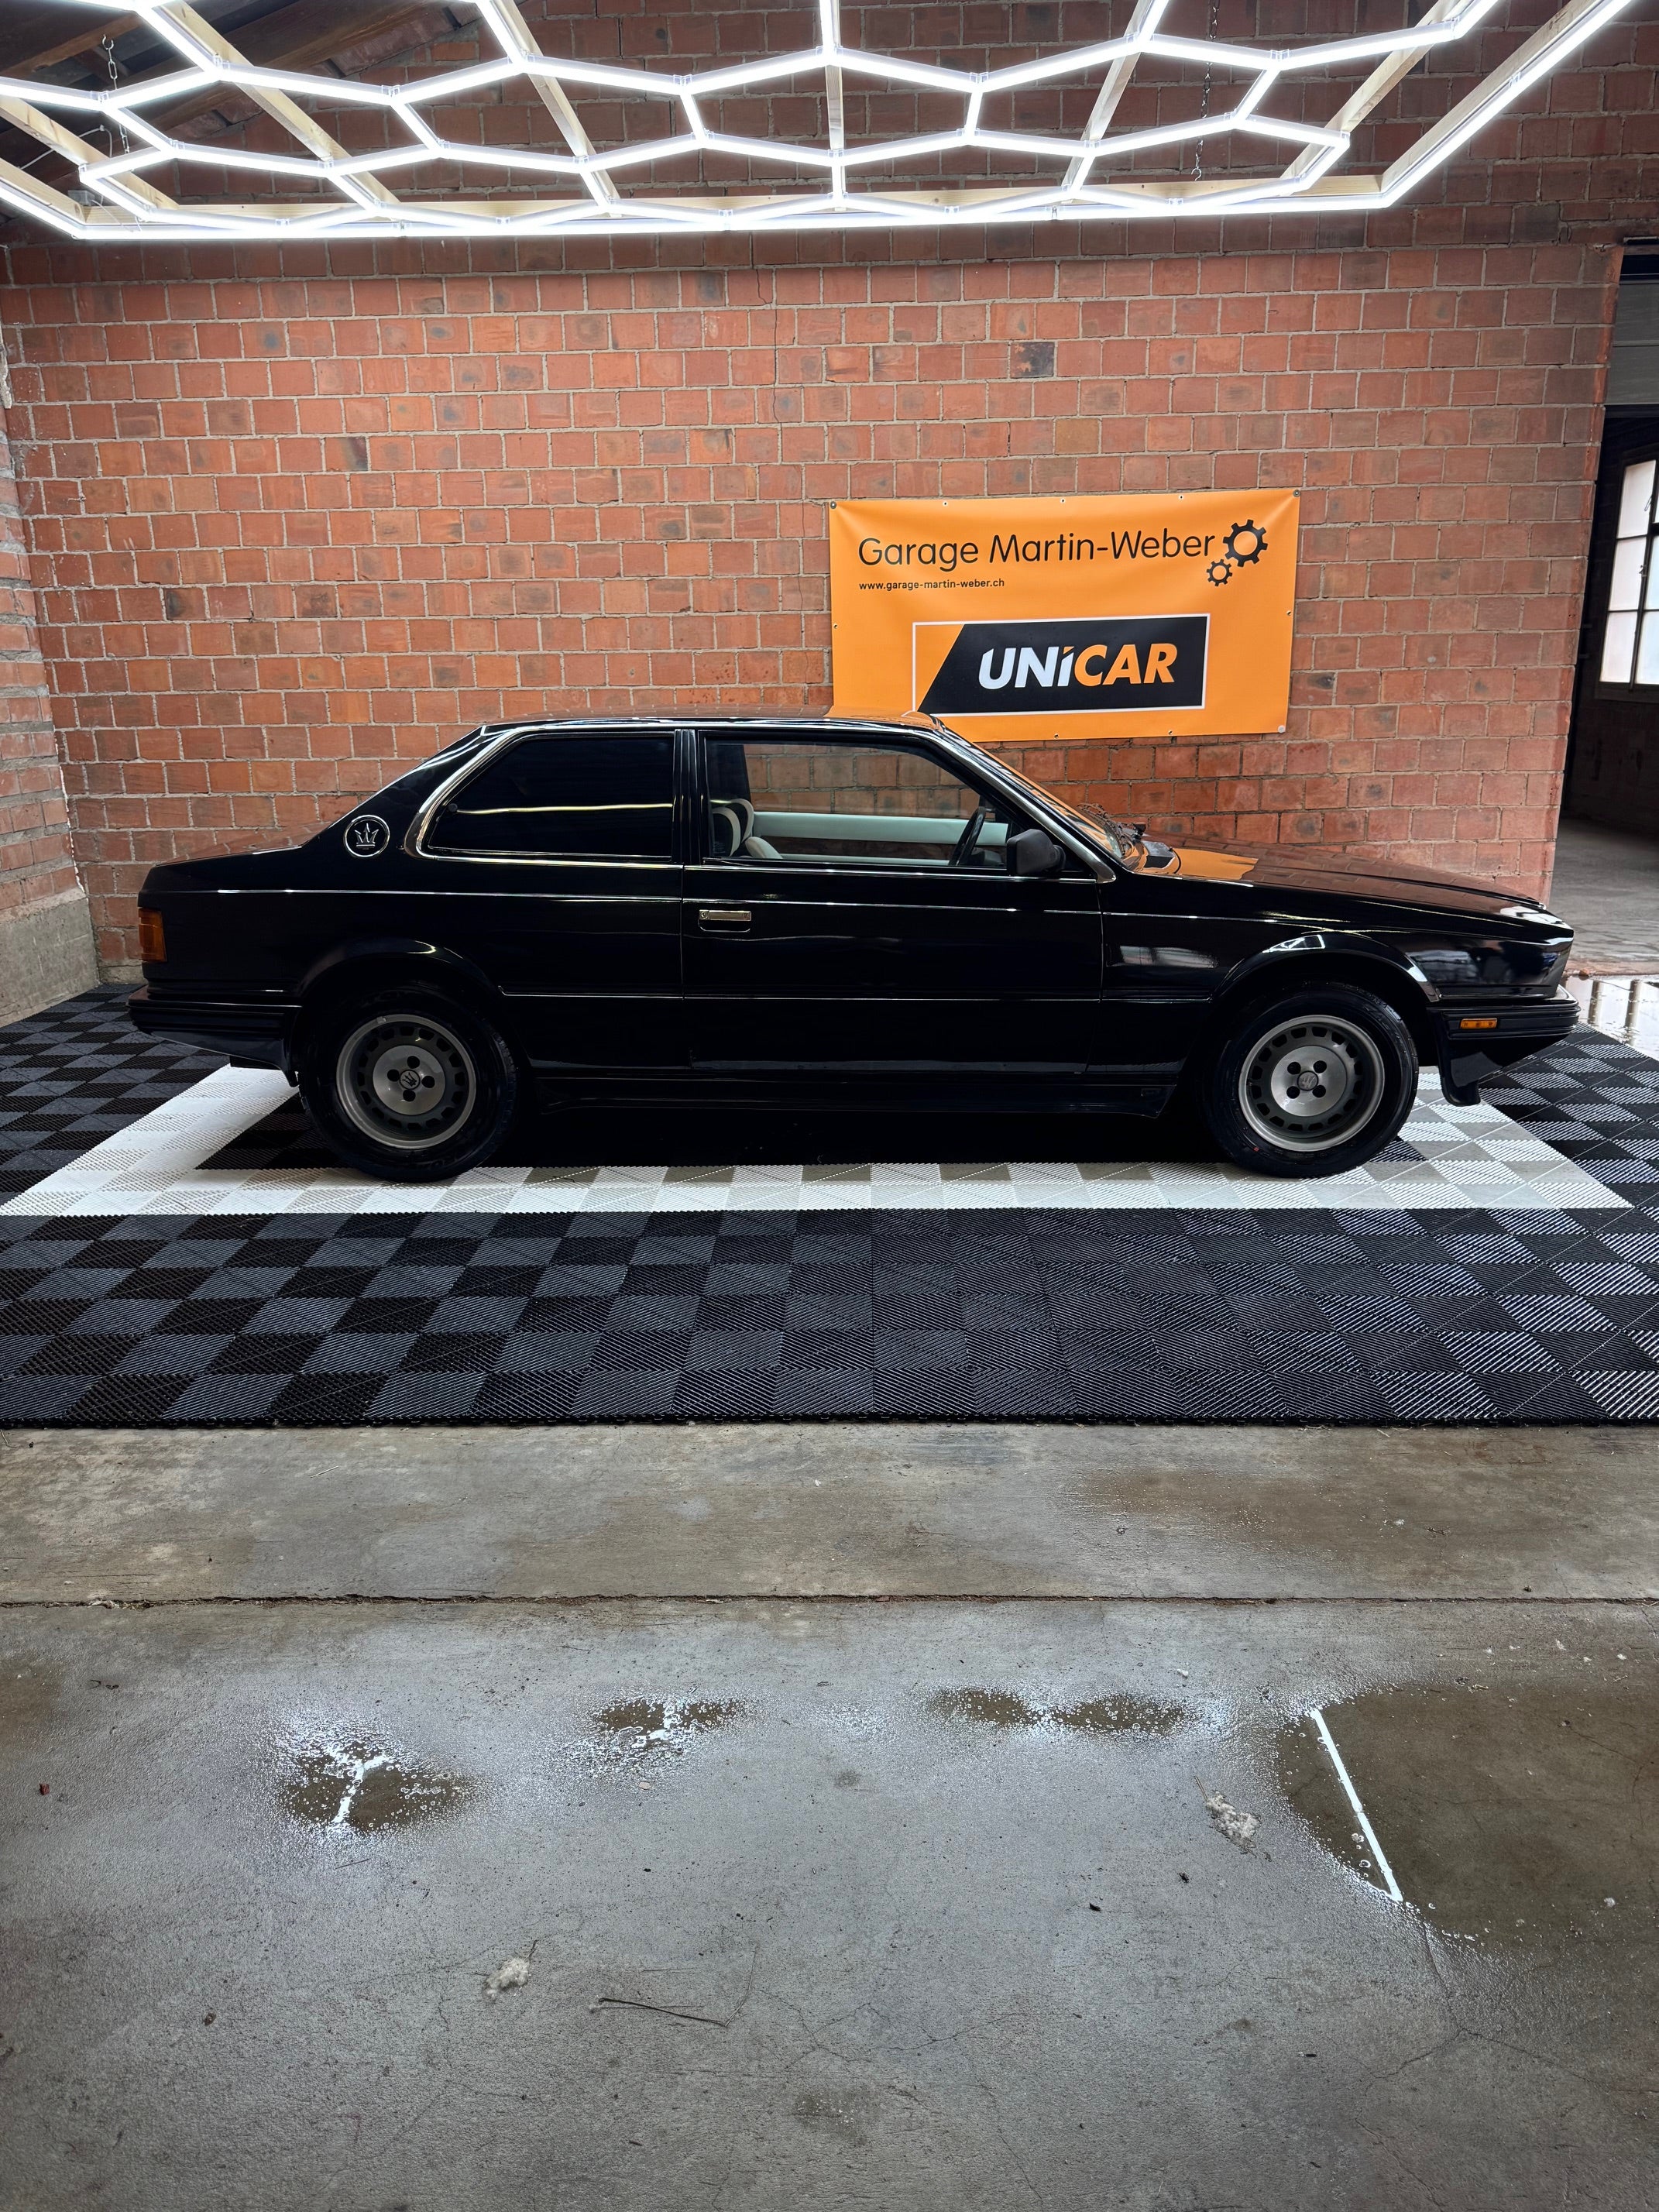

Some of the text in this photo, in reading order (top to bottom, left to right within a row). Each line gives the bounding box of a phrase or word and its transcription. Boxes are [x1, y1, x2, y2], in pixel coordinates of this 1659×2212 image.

[858, 528, 1216, 572] Garage Martin-Weber
[859, 578, 1005, 592] www.garage-martin-weber.ch
